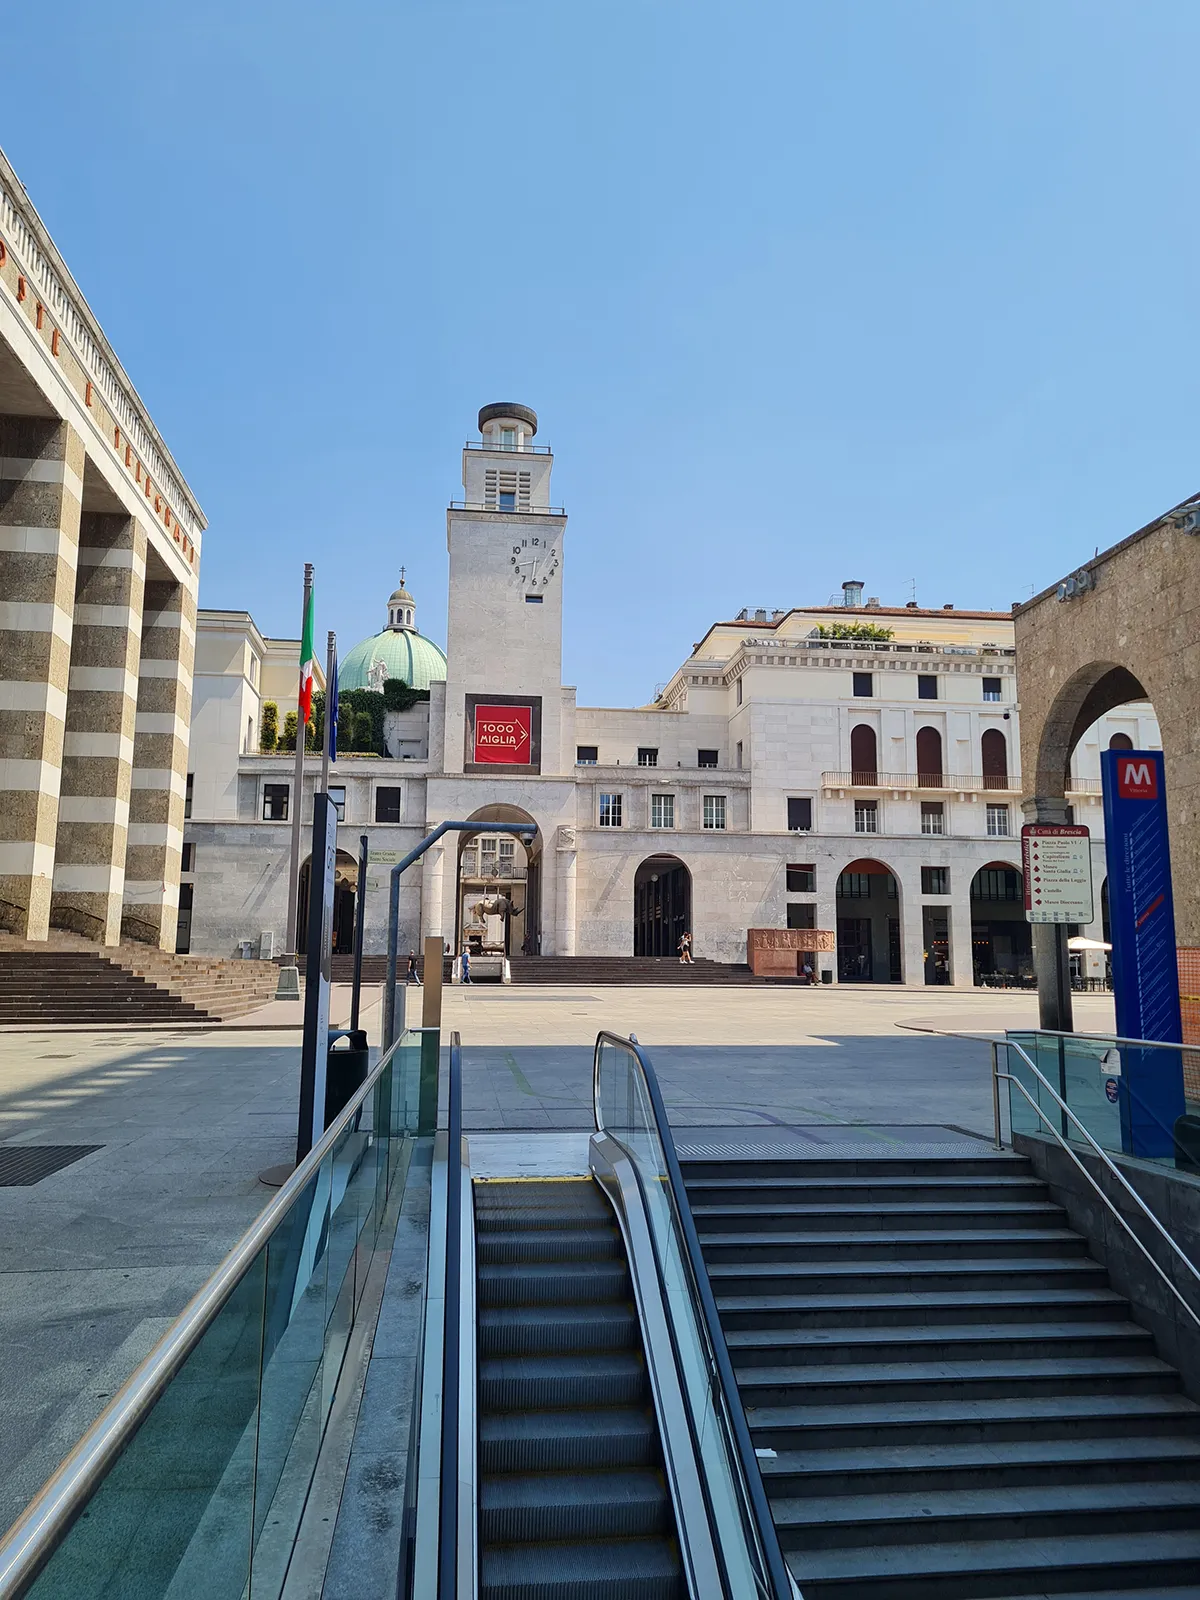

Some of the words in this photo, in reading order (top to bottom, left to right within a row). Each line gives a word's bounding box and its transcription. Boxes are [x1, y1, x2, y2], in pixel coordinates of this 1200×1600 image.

[515, 566, 520, 574] 8
[483, 724, 514, 733] 1000
[480, 735, 516, 744] MIGLIA
[1124, 763, 1152, 785] M
